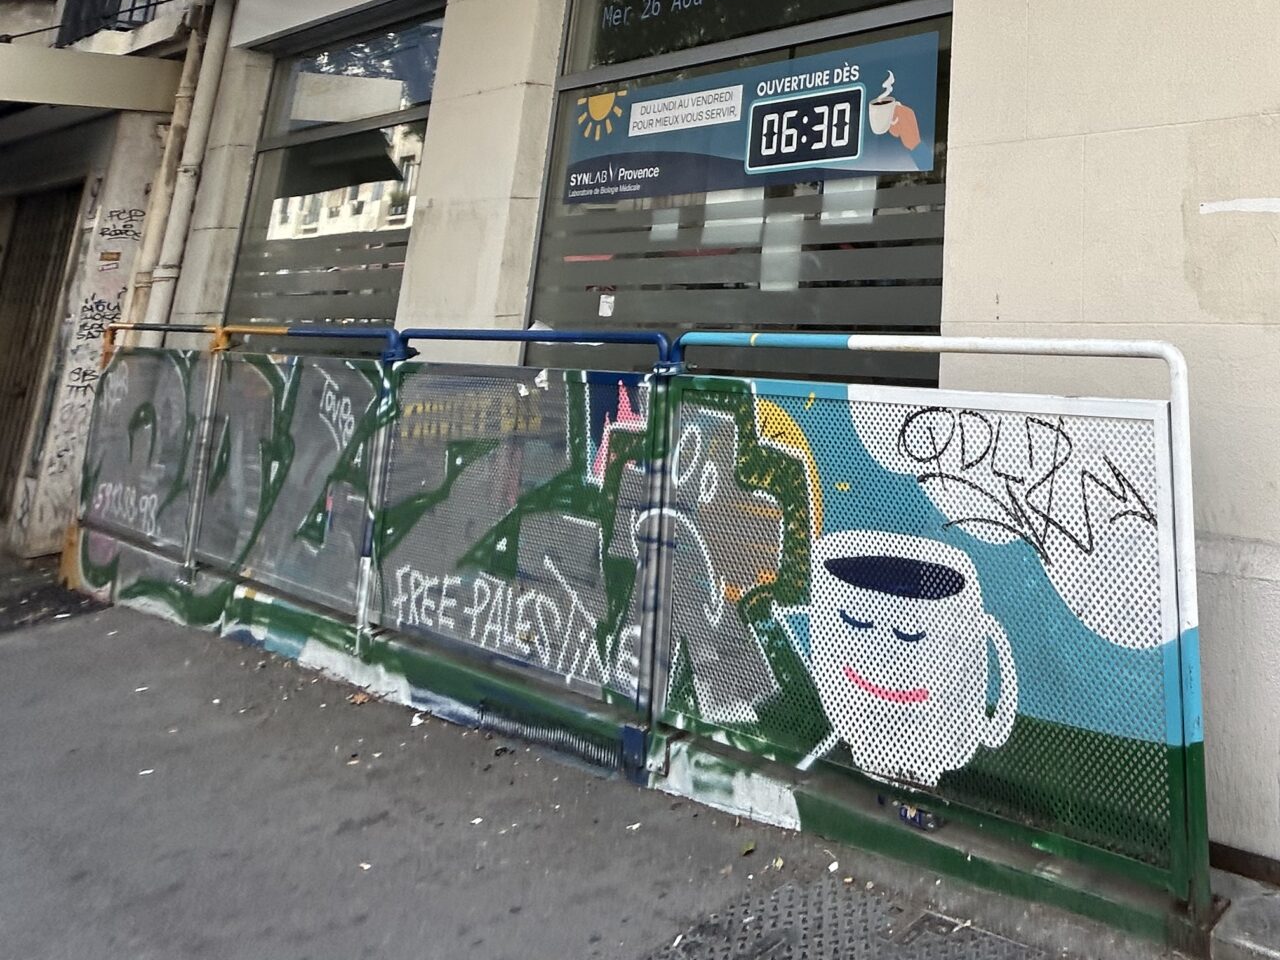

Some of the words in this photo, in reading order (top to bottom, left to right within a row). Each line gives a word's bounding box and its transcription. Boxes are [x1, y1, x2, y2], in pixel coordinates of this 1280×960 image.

[602, 4, 632, 29] Mer
[757, 70, 830, 96] OUVERTURE
[834, 63, 860, 84] DÈS
[640, 104, 652, 116] DU
[653, 100, 677, 113] LUNDI
[678, 97, 690, 109] AU
[691, 90, 733, 107] VENDREDI
[632, 118, 655, 131] POUR
[655, 115, 681, 129] MIEUX
[681, 111, 704, 125] VOUS
[705, 106, 738, 121] SERVIR,
[761, 102, 850, 156] 06:30
[570, 171, 607, 186] SYNLAB
[618, 167, 660, 181] Provence
[568, 188, 593, 197] Laboratoire
[600, 185, 619, 195] Biologie
[392, 564, 462, 630] FREE
